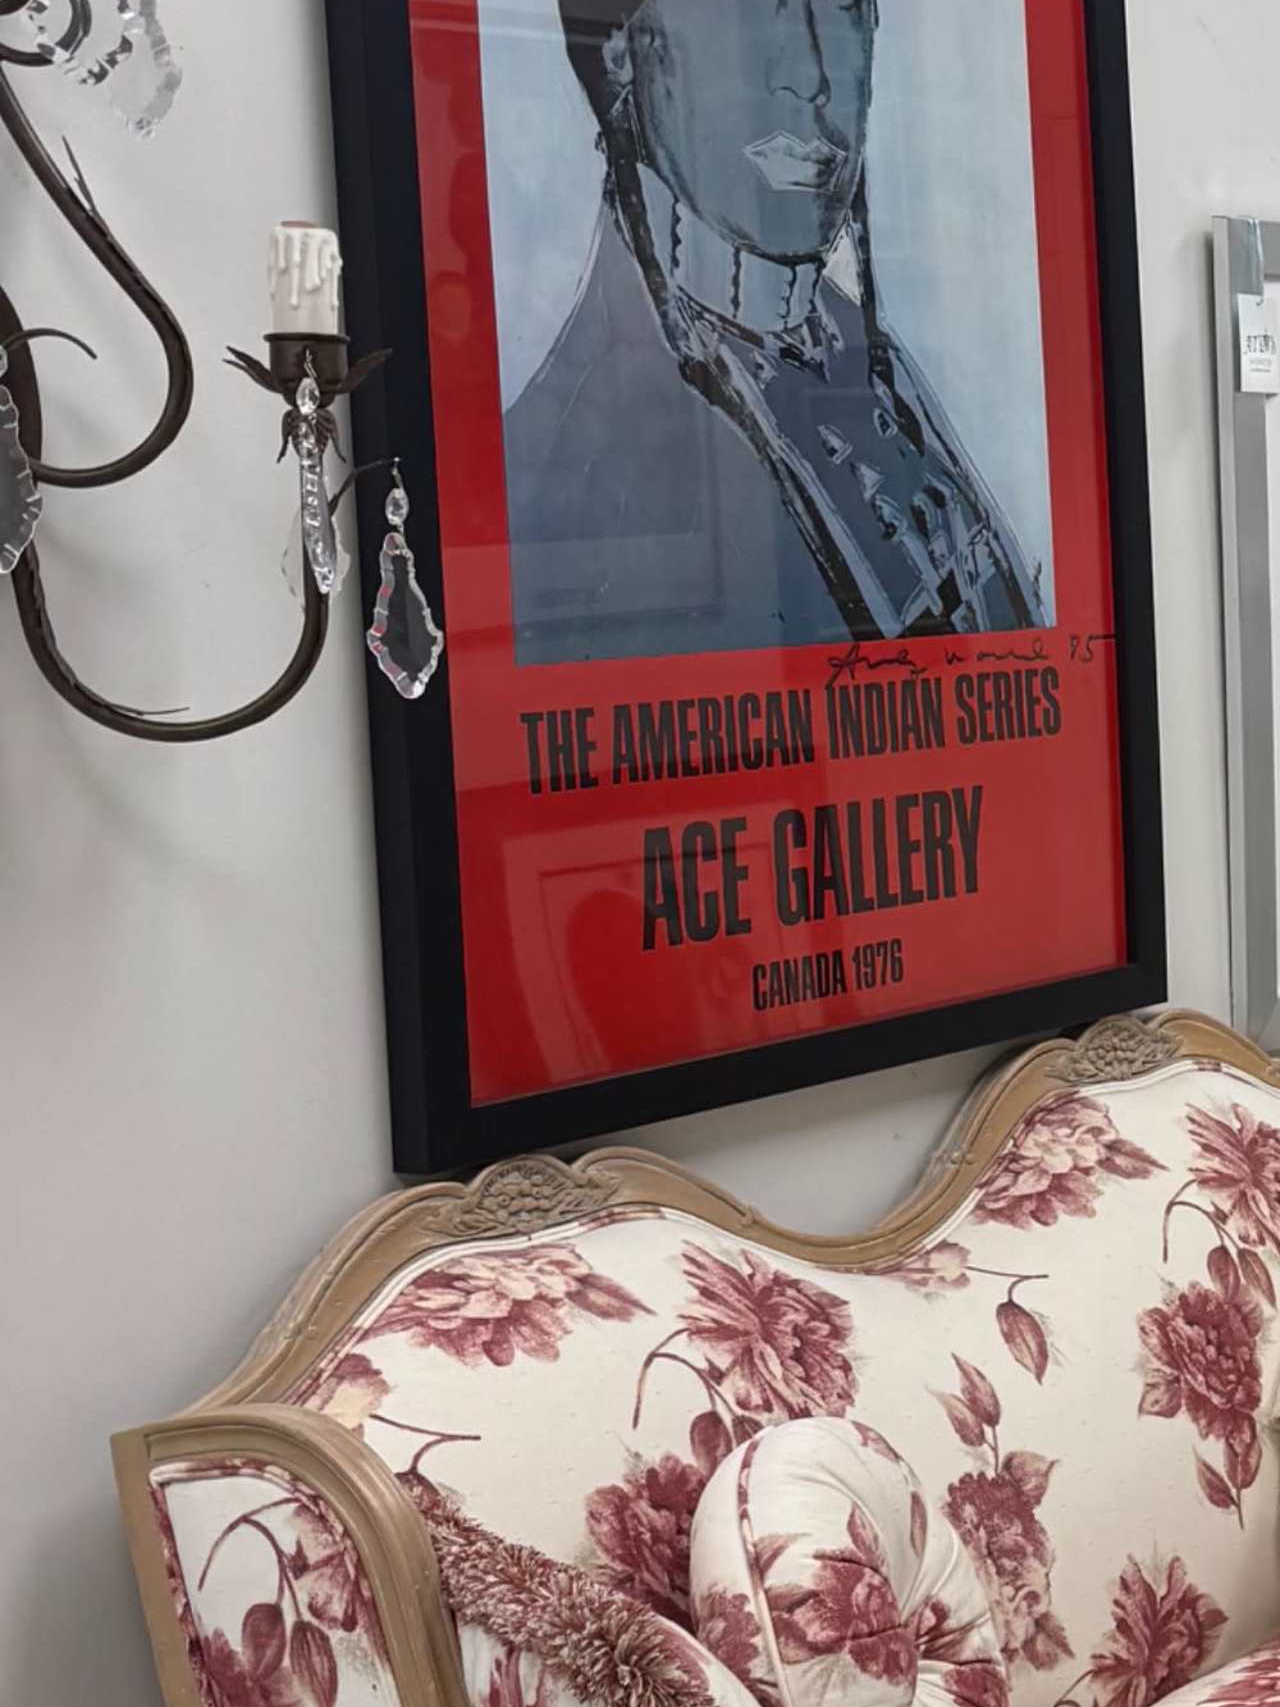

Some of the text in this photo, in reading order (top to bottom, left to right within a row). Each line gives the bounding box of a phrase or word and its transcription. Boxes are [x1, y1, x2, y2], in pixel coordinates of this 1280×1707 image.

[519, 665, 1062, 795] THE AMERICAN INDIAN SERIES
[641, 784, 985, 951] ACE GALLERY
[751, 937, 904, 1012] CANADA 1976
